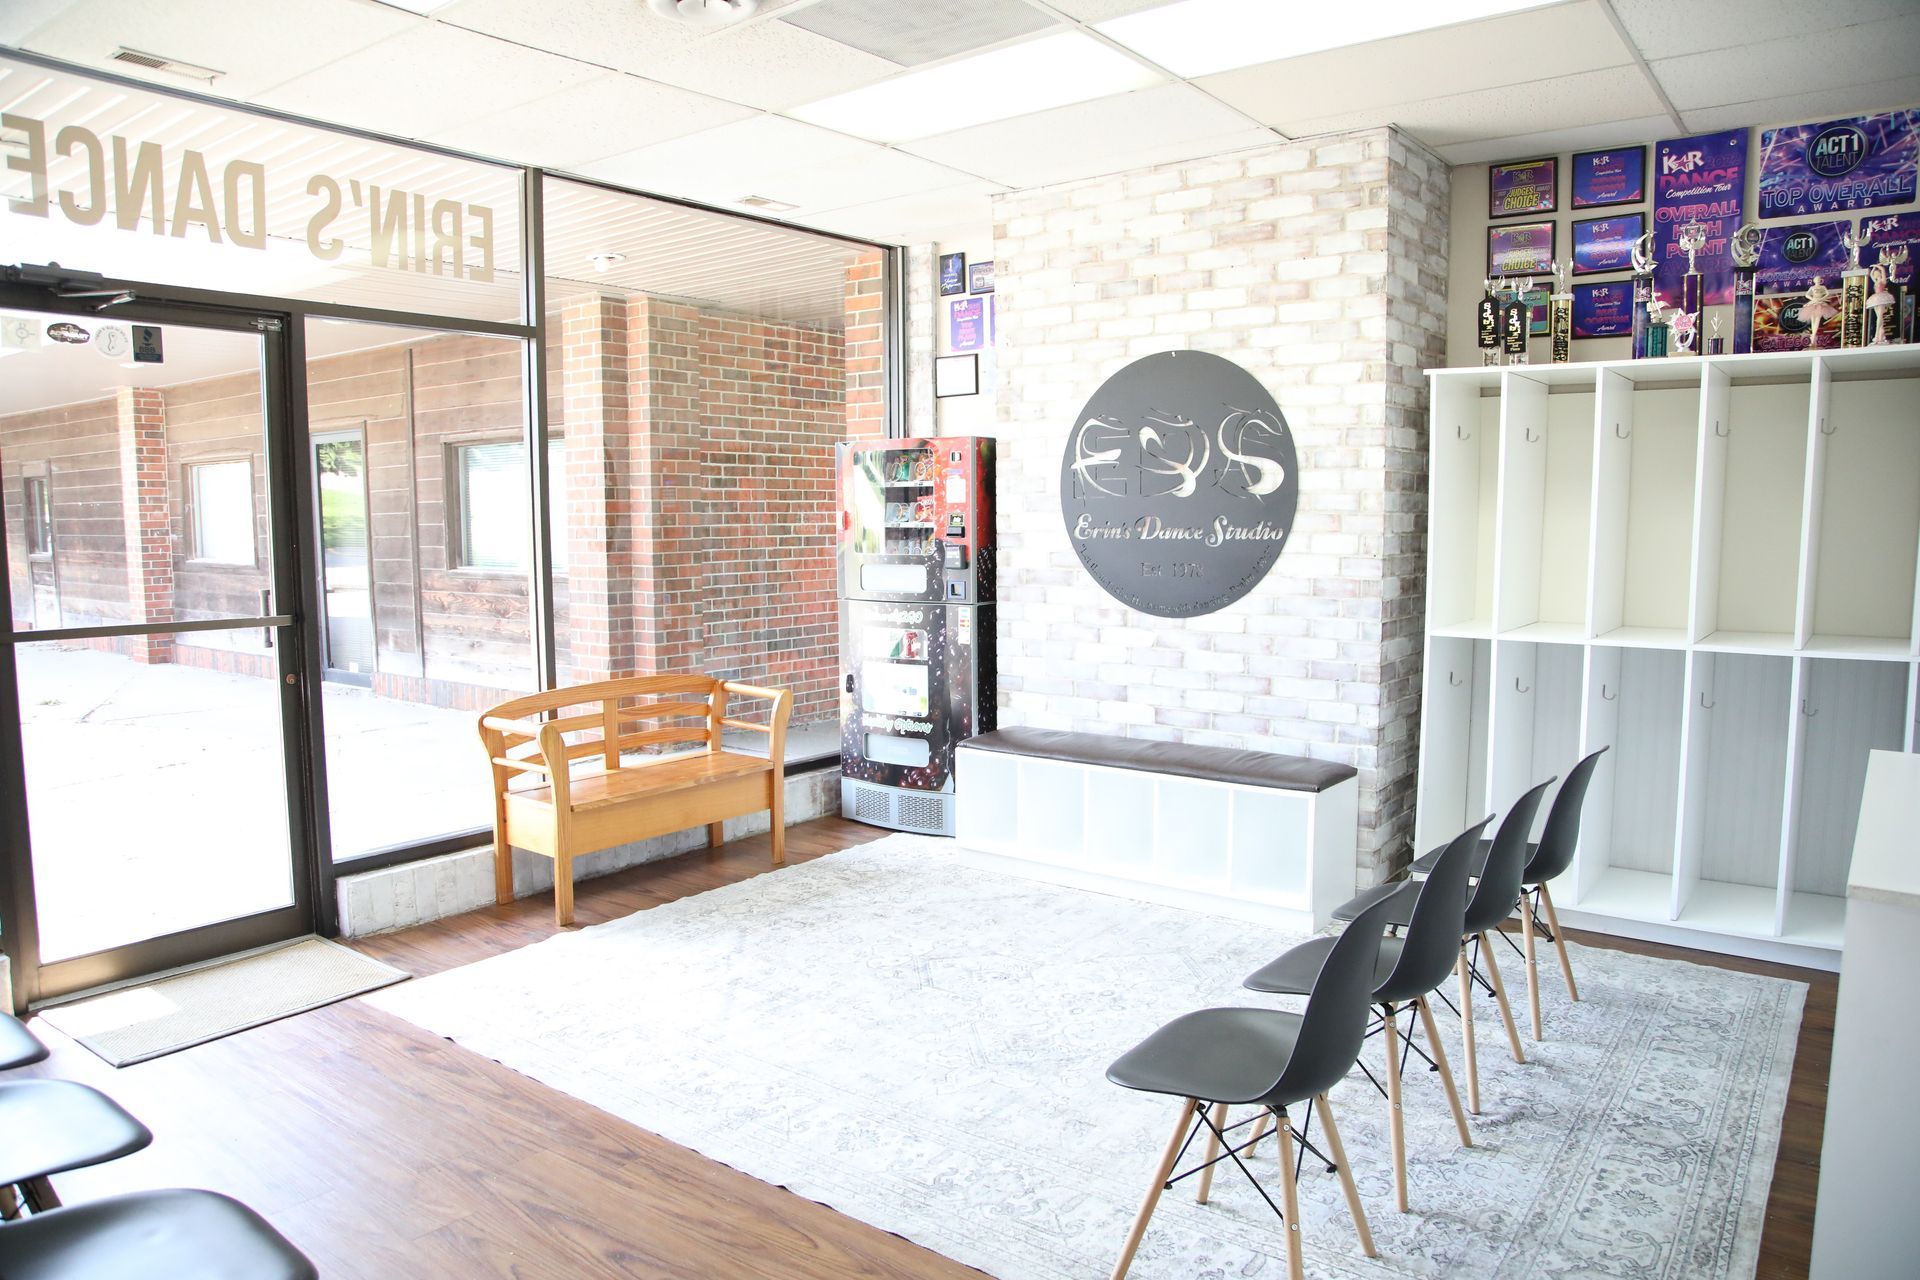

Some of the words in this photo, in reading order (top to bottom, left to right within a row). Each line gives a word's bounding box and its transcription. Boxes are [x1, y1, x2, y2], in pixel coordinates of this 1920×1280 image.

[1815, 151, 1859, 170] TALENT
[1658, 166, 1740, 192] DANCE
[1665, 185, 1713, 199] Competition
[1713, 181, 1732, 193] Tour
[1763, 187, 1804, 209] TOP
[1808, 174, 1913, 204] OVERALL
[1504, 193, 1539, 210] CHOICE
[1655, 198, 1741, 224] OVERALL
[1797, 197, 1873, 214] AWARD
[1671, 219, 1722, 242] HH
[1502, 256, 1536, 272] CHOICE
[1074, 513, 1133, 541] Erin's
[1134, 515, 1204, 541] Dance
[1204, 514, 1285, 548] Studio
[1172, 561, 1204, 579] 1978
